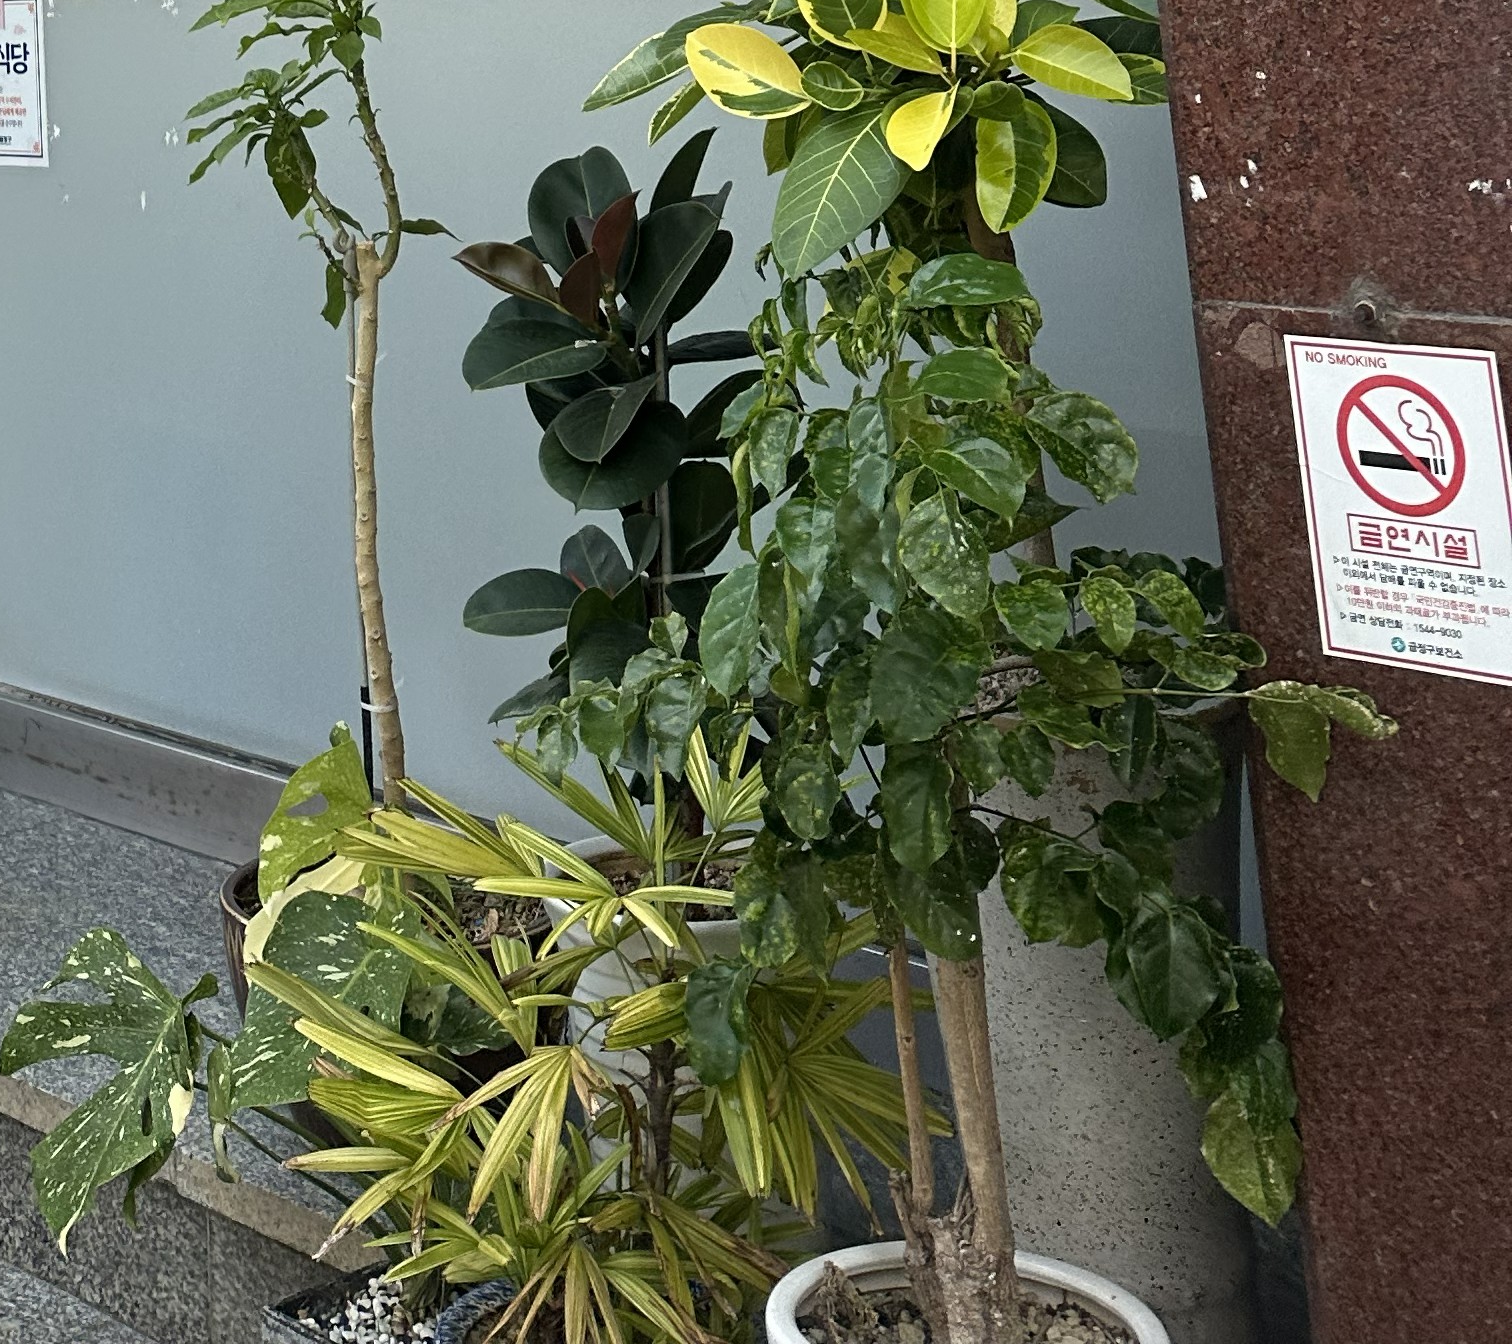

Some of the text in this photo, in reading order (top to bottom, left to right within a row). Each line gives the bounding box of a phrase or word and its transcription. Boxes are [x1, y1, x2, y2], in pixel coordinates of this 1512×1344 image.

[1305, 350, 1388, 370] NO SMOKING
[1357, 521, 1469, 561] 금연시설
[1349, 612, 1367, 624] 금연
[1408, 641, 1464, 659] 금정구보건소
